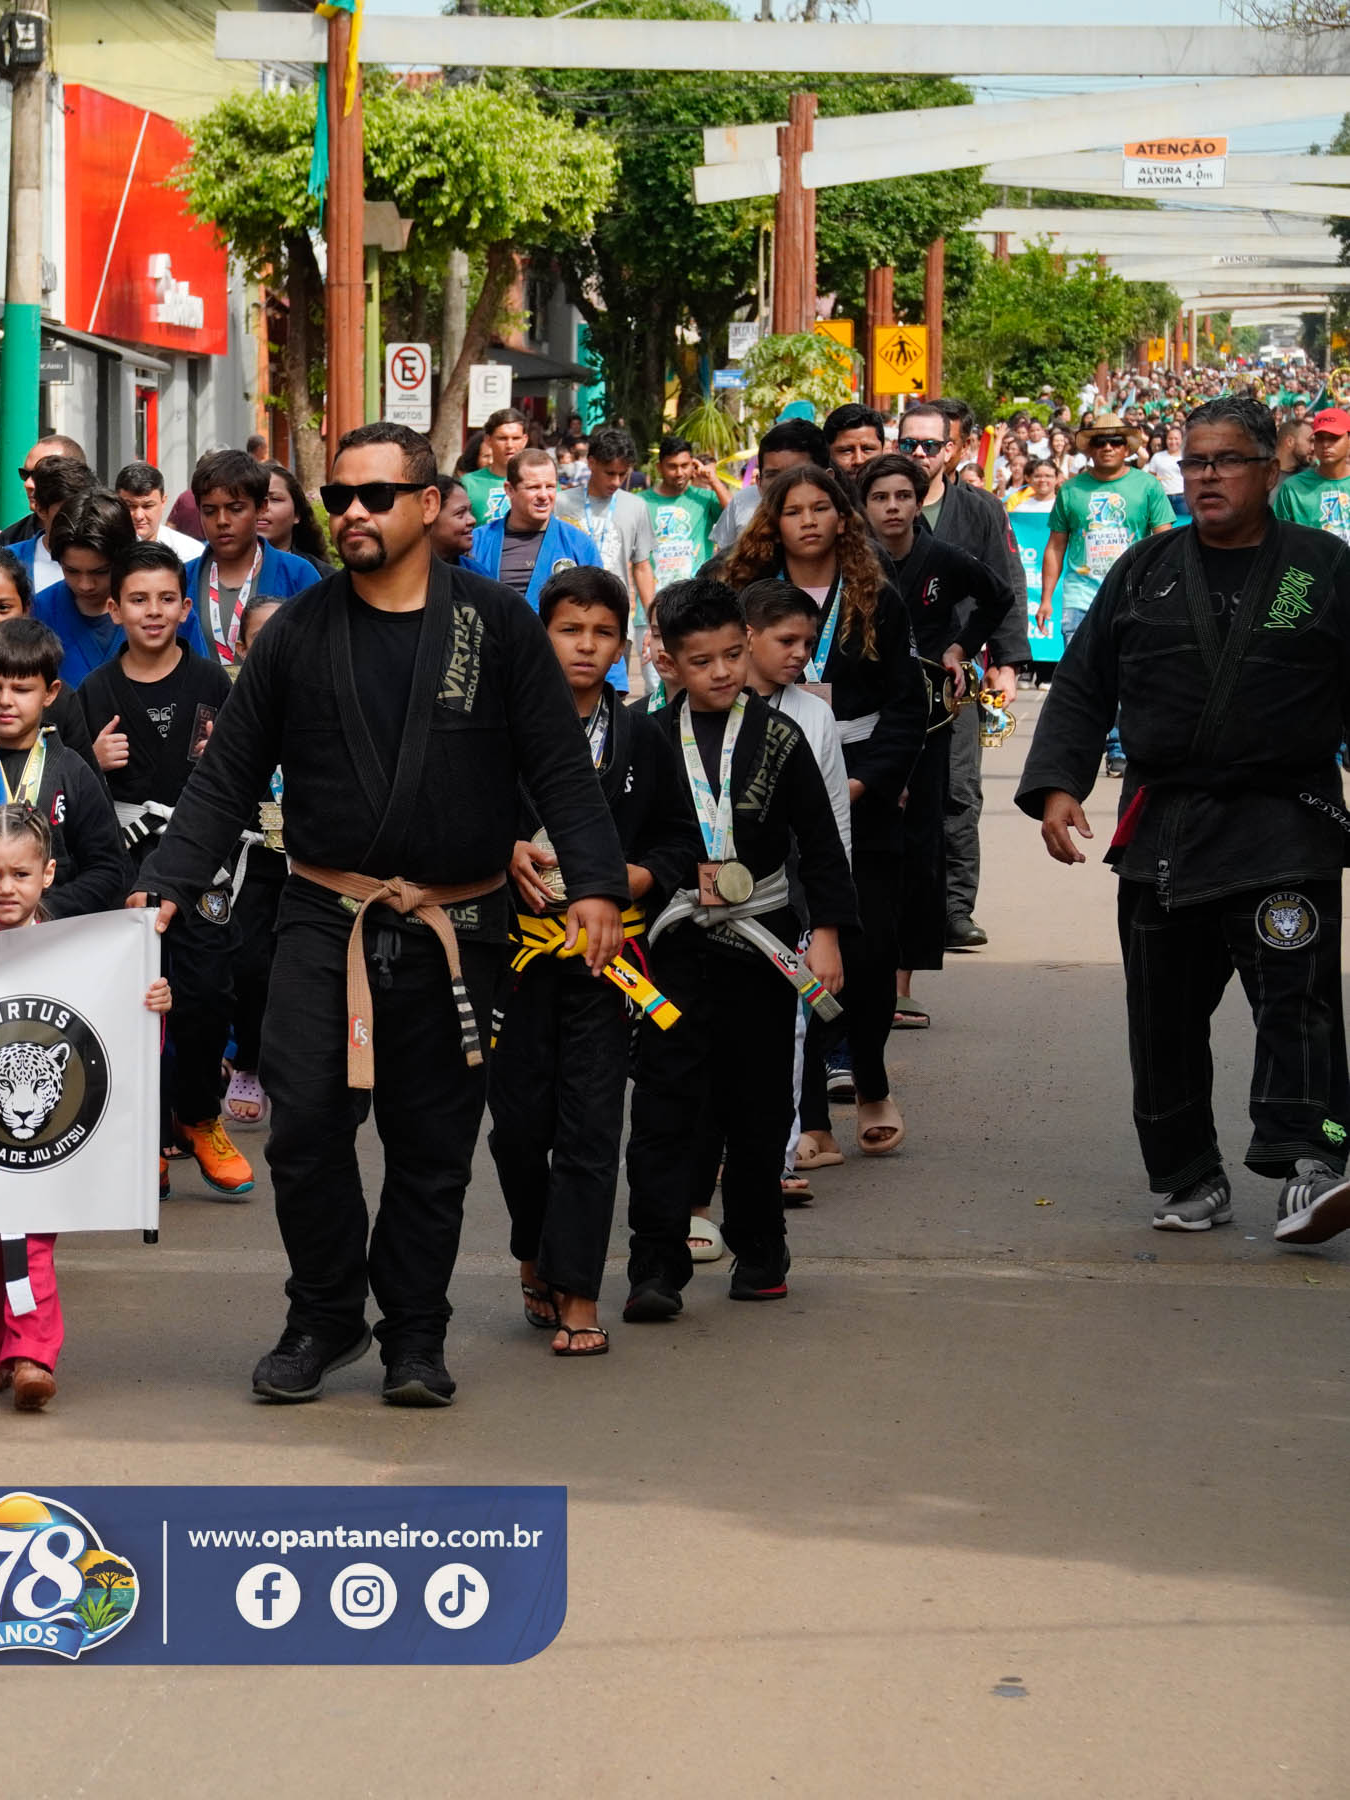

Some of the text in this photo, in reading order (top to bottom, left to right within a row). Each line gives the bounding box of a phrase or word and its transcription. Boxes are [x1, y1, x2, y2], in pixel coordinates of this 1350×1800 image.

[1135, 139, 1216, 156] ATENÇÃO
[1139, 167, 1182, 175] ALTURA
[484, 375, 497, 393] E
[393, 411, 422, 420] MOTOS
[1263, 566, 1317, 629] VENUM
[438, 606, 476, 698] VIRTUS
[736, 717, 792, 810] VIRTUS
[1267, 893, 1302, 905] VIRTUS
[9, 1151, 26, 1163] DE
[29, 1148, 51, 1163] JIU
[53, 1124, 86, 1156] JITSU
